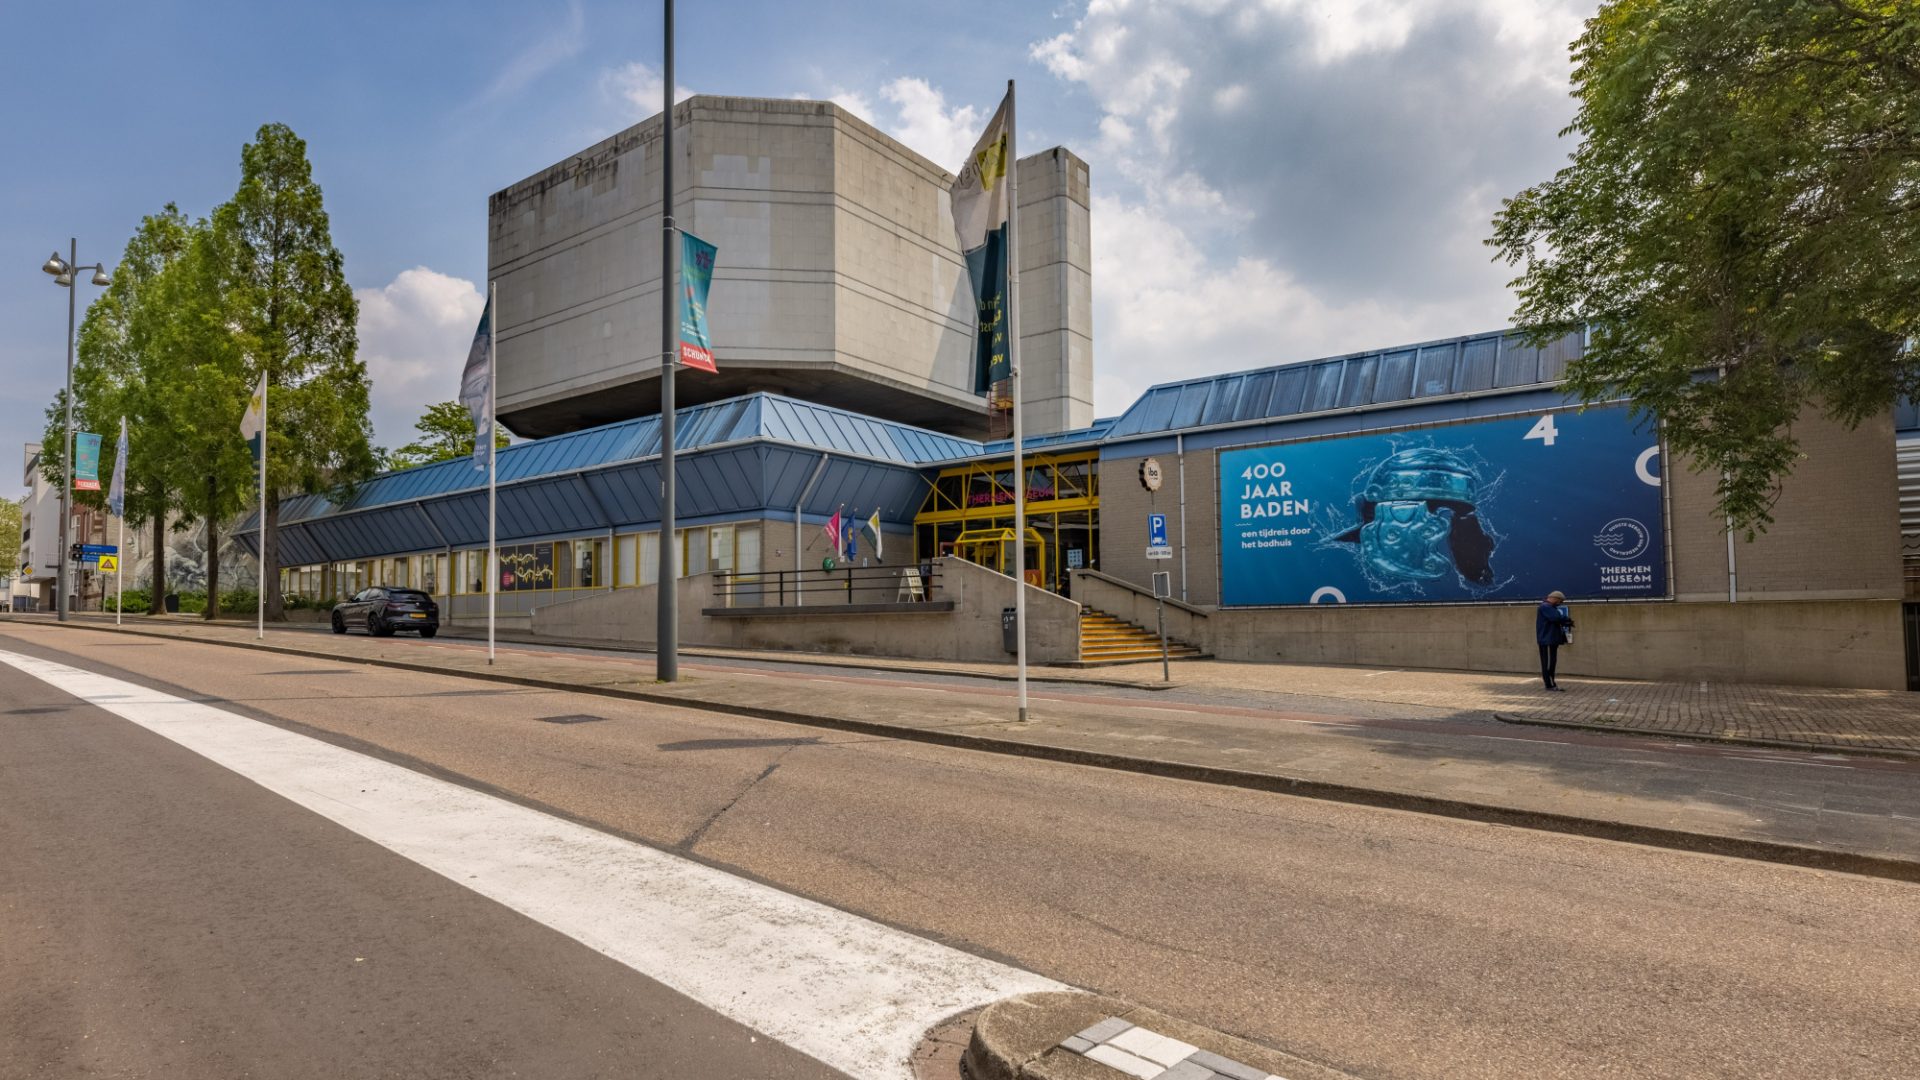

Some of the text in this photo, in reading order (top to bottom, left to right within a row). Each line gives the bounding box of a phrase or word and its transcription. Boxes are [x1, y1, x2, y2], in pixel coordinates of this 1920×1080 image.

[1523, 415, 1558, 446] 4
[1241, 462, 1286, 480] 400
[1241, 481, 1293, 500] JAAR
[1241, 499, 1309, 519] BADEN
[1153, 517, 1162, 533] P
[1259, 528, 1289, 538] tijdreis
[1290, 527, 1311, 535] door
[1241, 539, 1292, 549] het badhuis
[1600, 565, 1651, 574] THERMEN
